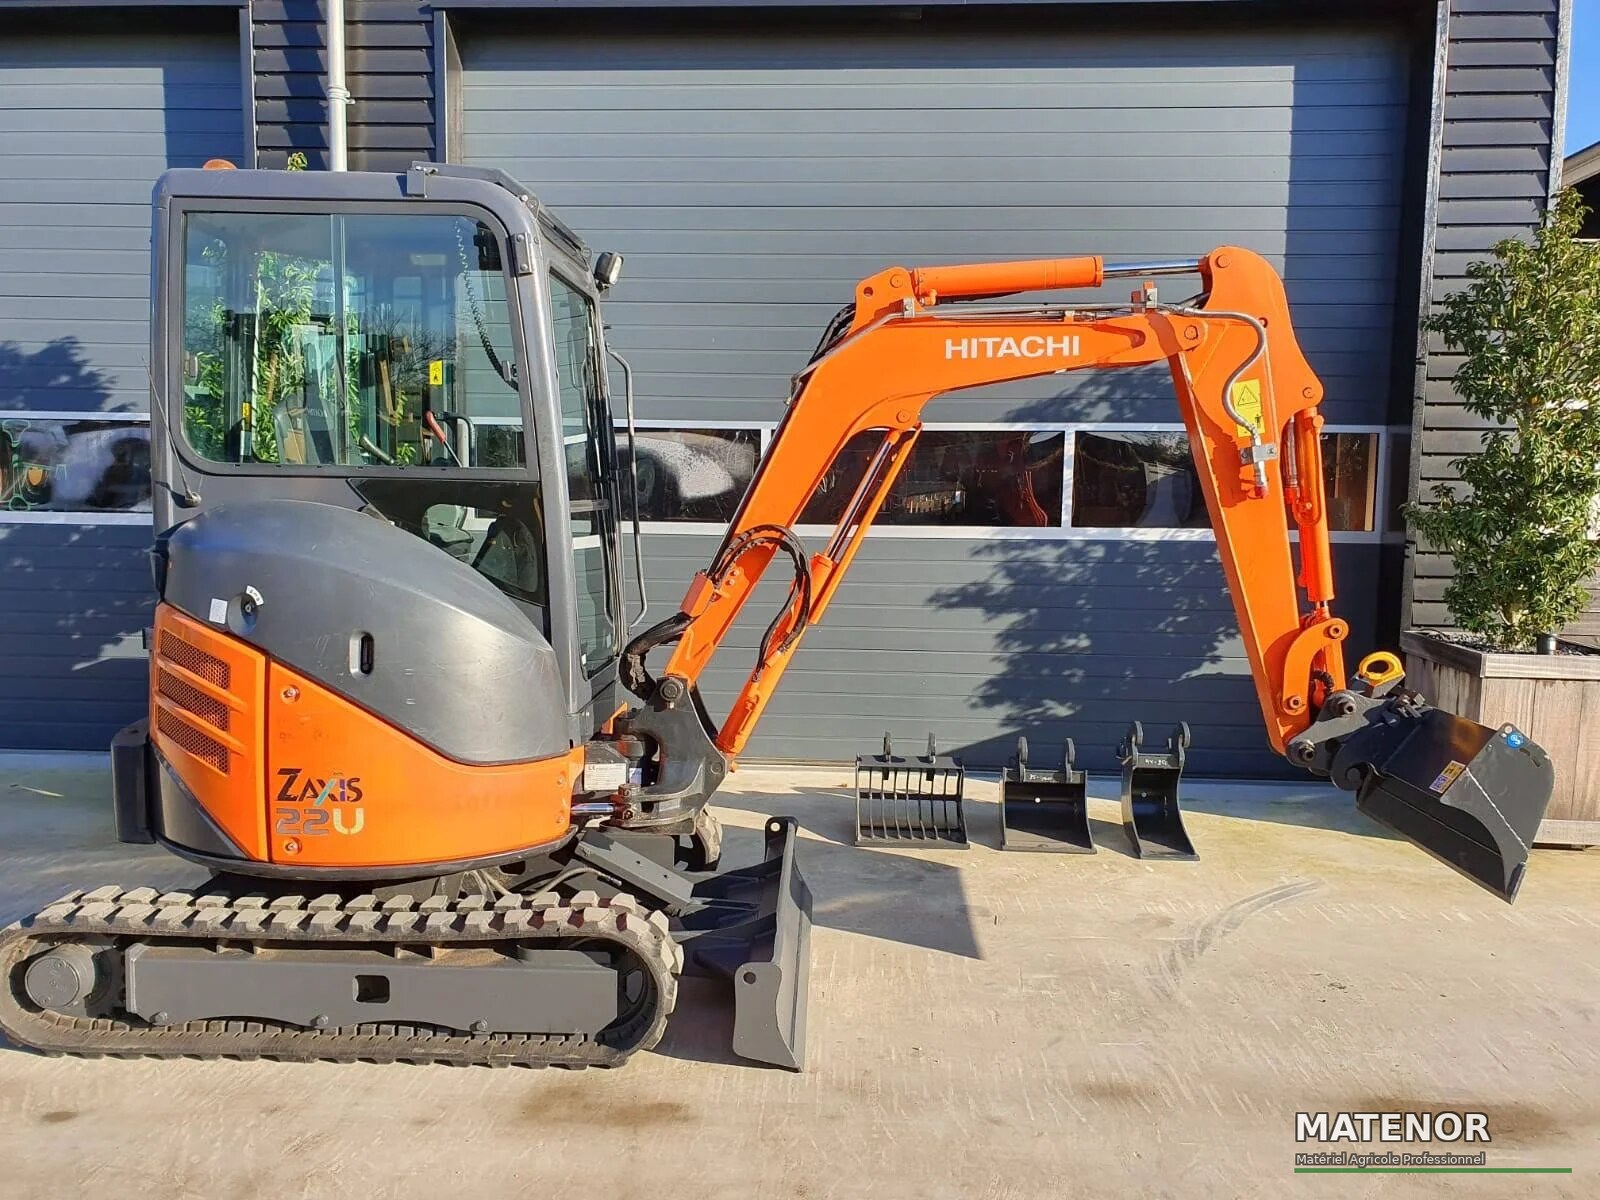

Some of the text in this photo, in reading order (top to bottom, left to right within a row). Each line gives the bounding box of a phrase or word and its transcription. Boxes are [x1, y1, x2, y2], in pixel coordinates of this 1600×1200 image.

[945, 335, 1080, 359] HITACHI
[277, 768, 363, 806] ZAXIS
[276, 808, 364, 835] 22U
